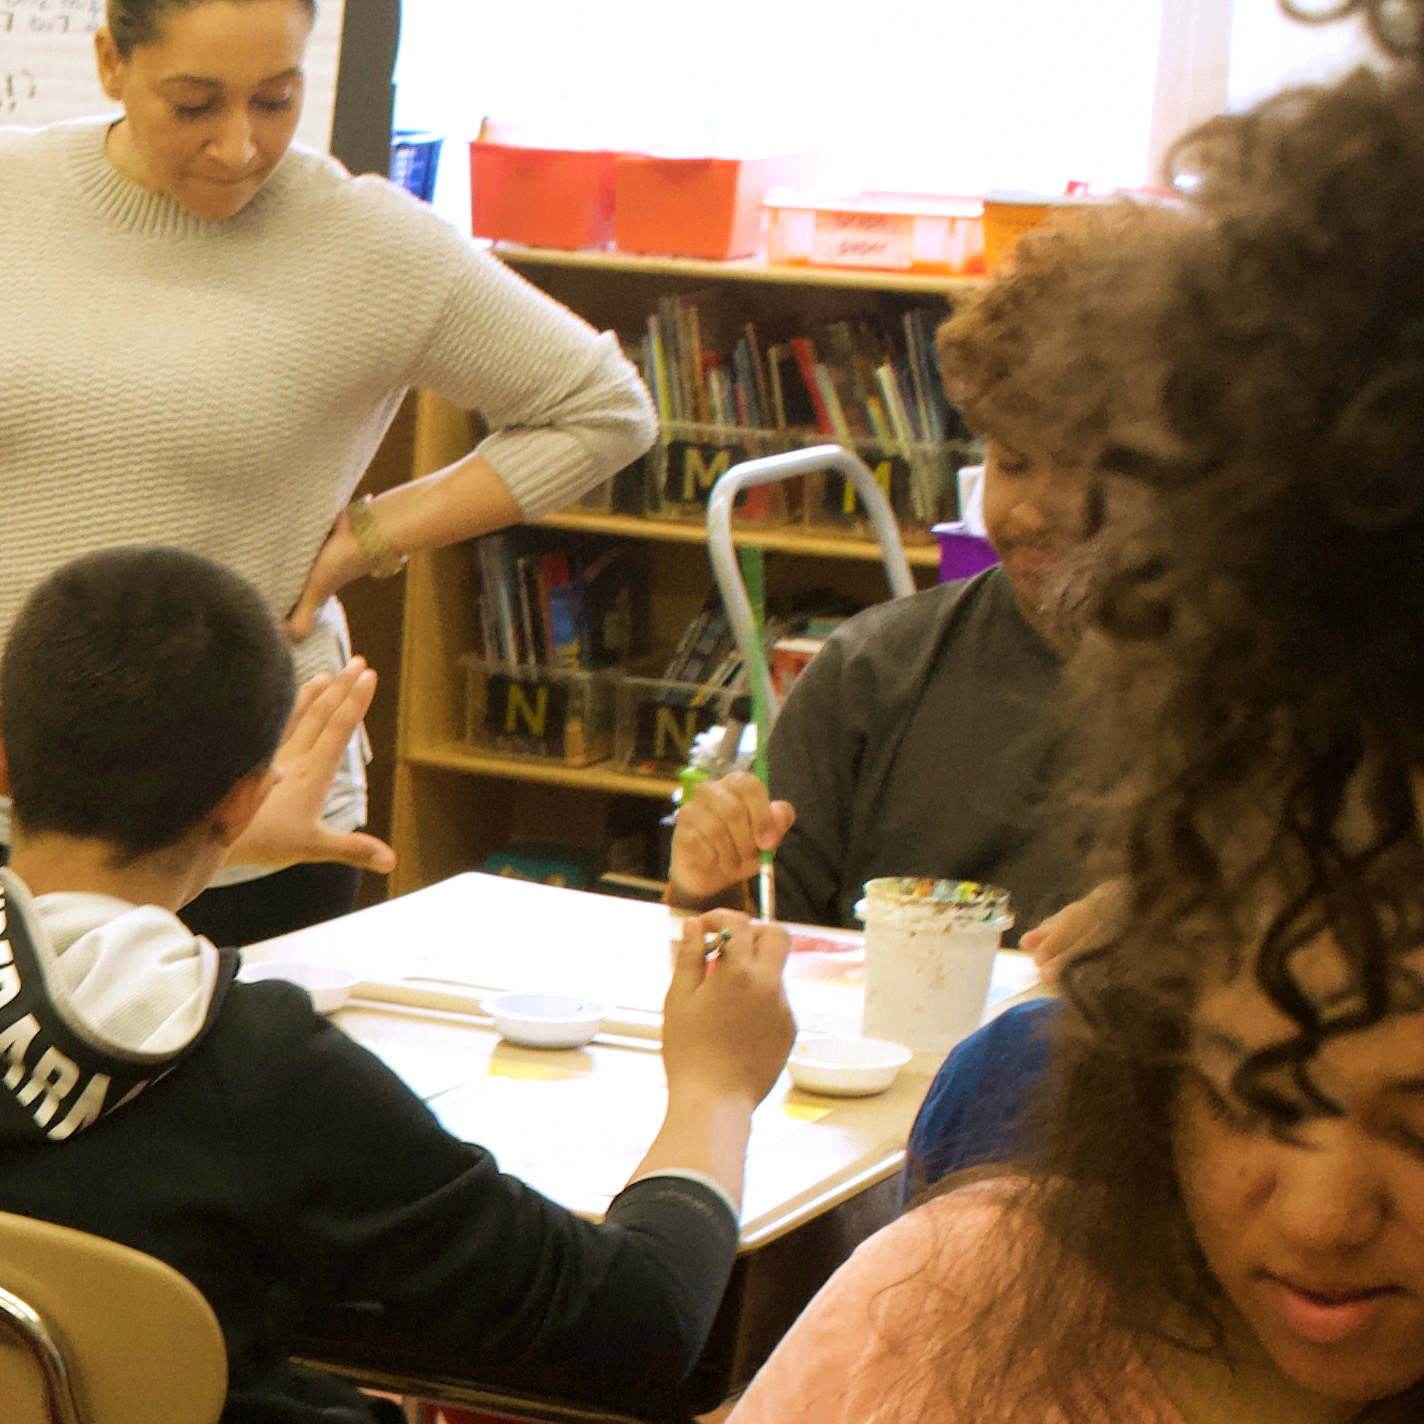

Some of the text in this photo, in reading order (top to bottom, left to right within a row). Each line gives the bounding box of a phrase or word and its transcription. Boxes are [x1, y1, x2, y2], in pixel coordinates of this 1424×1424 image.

[683, 449, 731, 500] M
[505, 683, 549, 737] N
[654, 707, 699, 759] N
